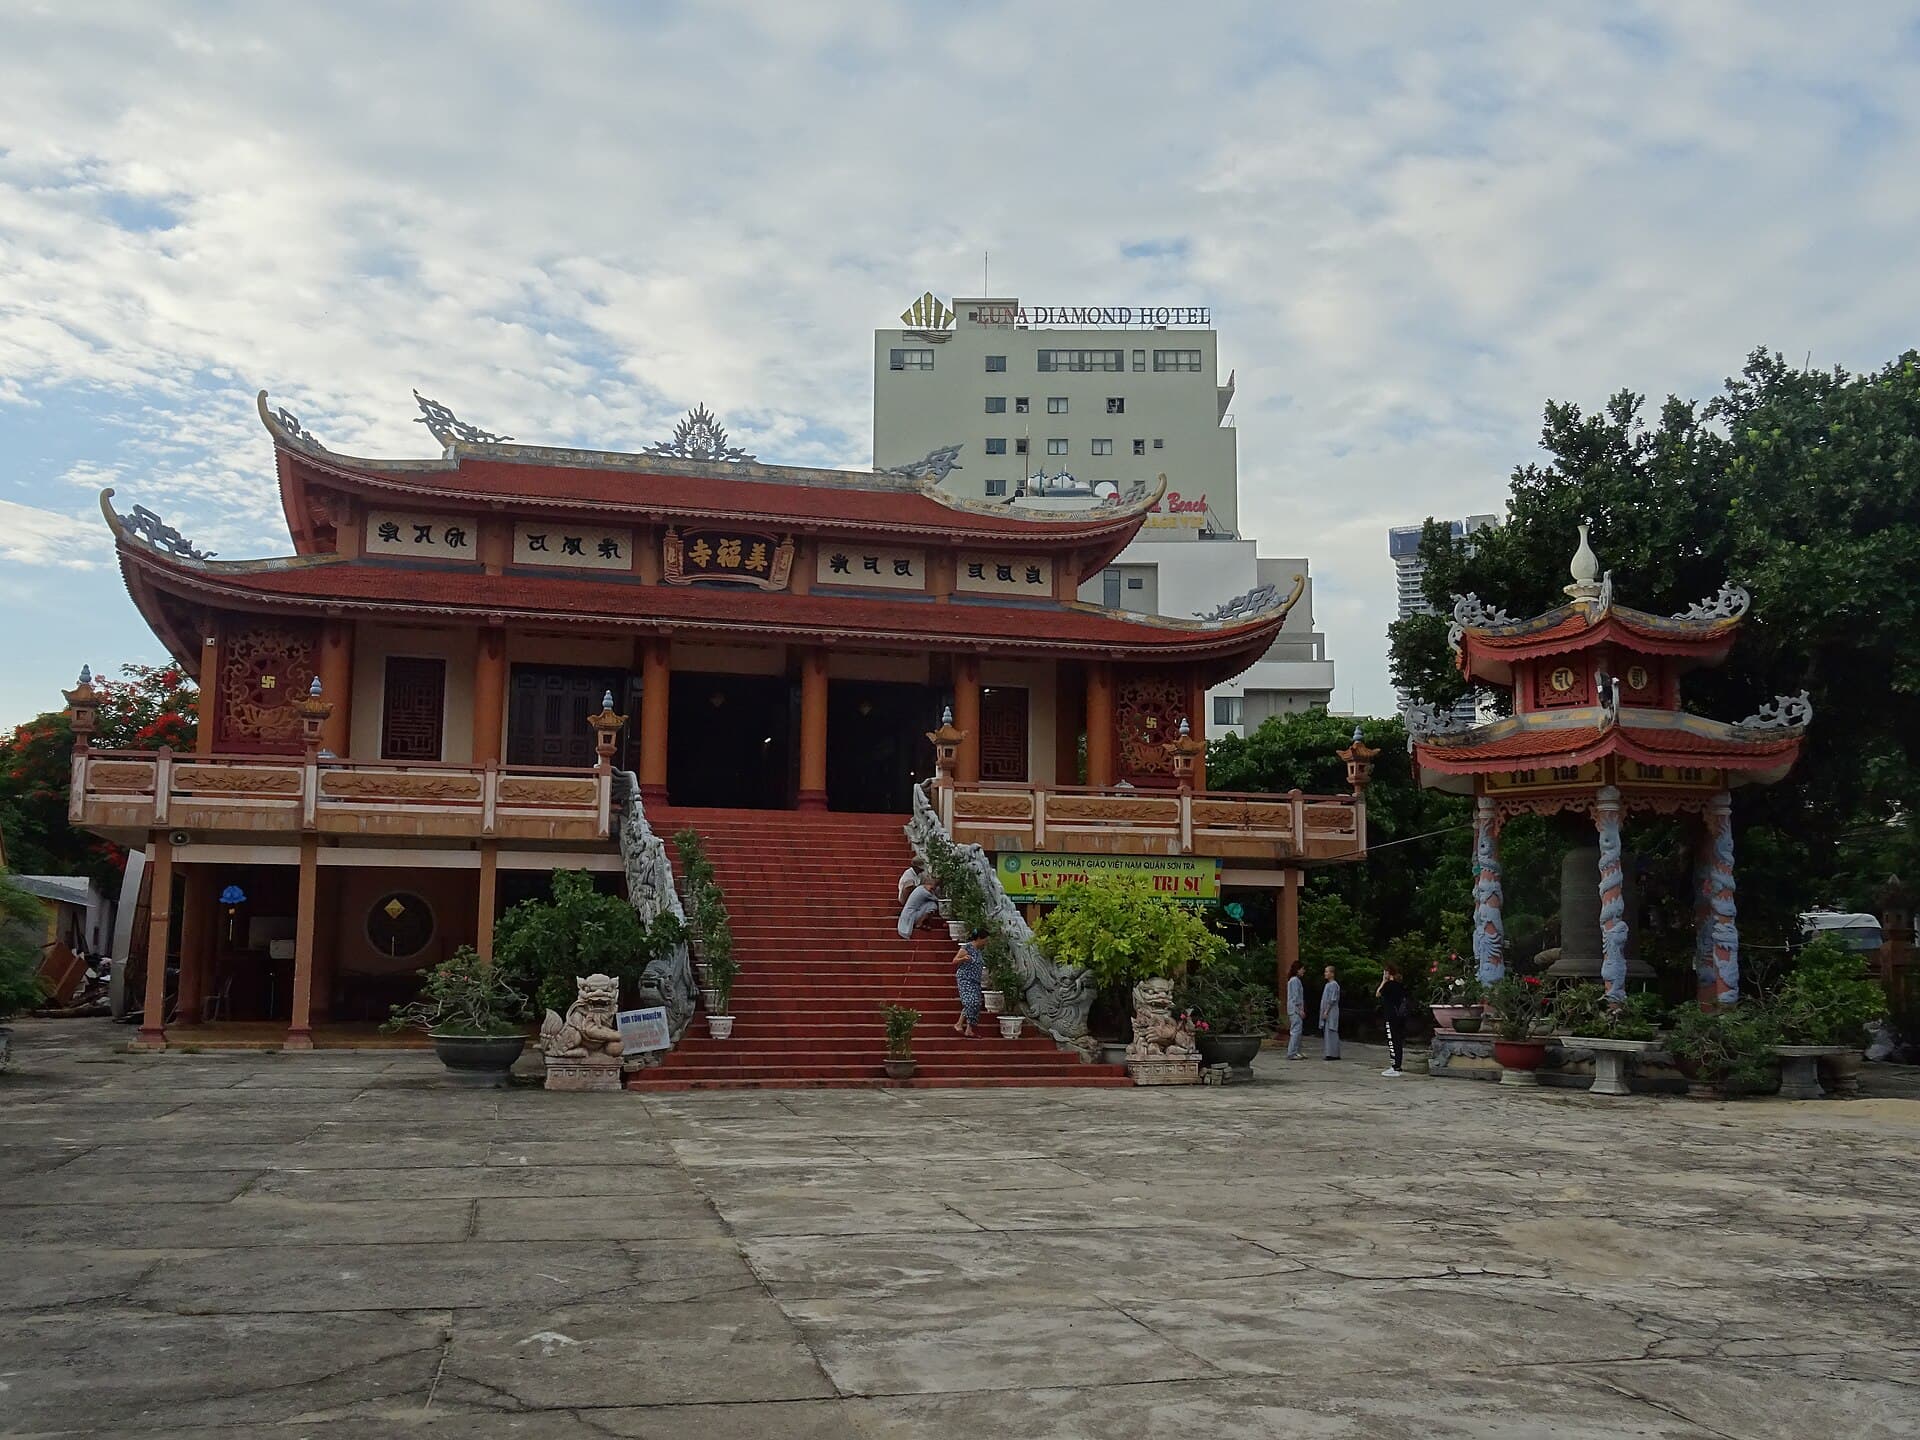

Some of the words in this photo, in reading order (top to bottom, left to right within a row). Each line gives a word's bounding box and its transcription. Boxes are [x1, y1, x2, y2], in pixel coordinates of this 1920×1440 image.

[977, 306, 1028, 324] LUNA
[1034, 306, 1131, 324] DIAMOND
[1140, 306, 1211, 324] HOTEL
[1125, 861, 1141, 870] NAM
[1152, 875, 1180, 895] TRỊ
[1184, 873, 1205, 896] SỰ
